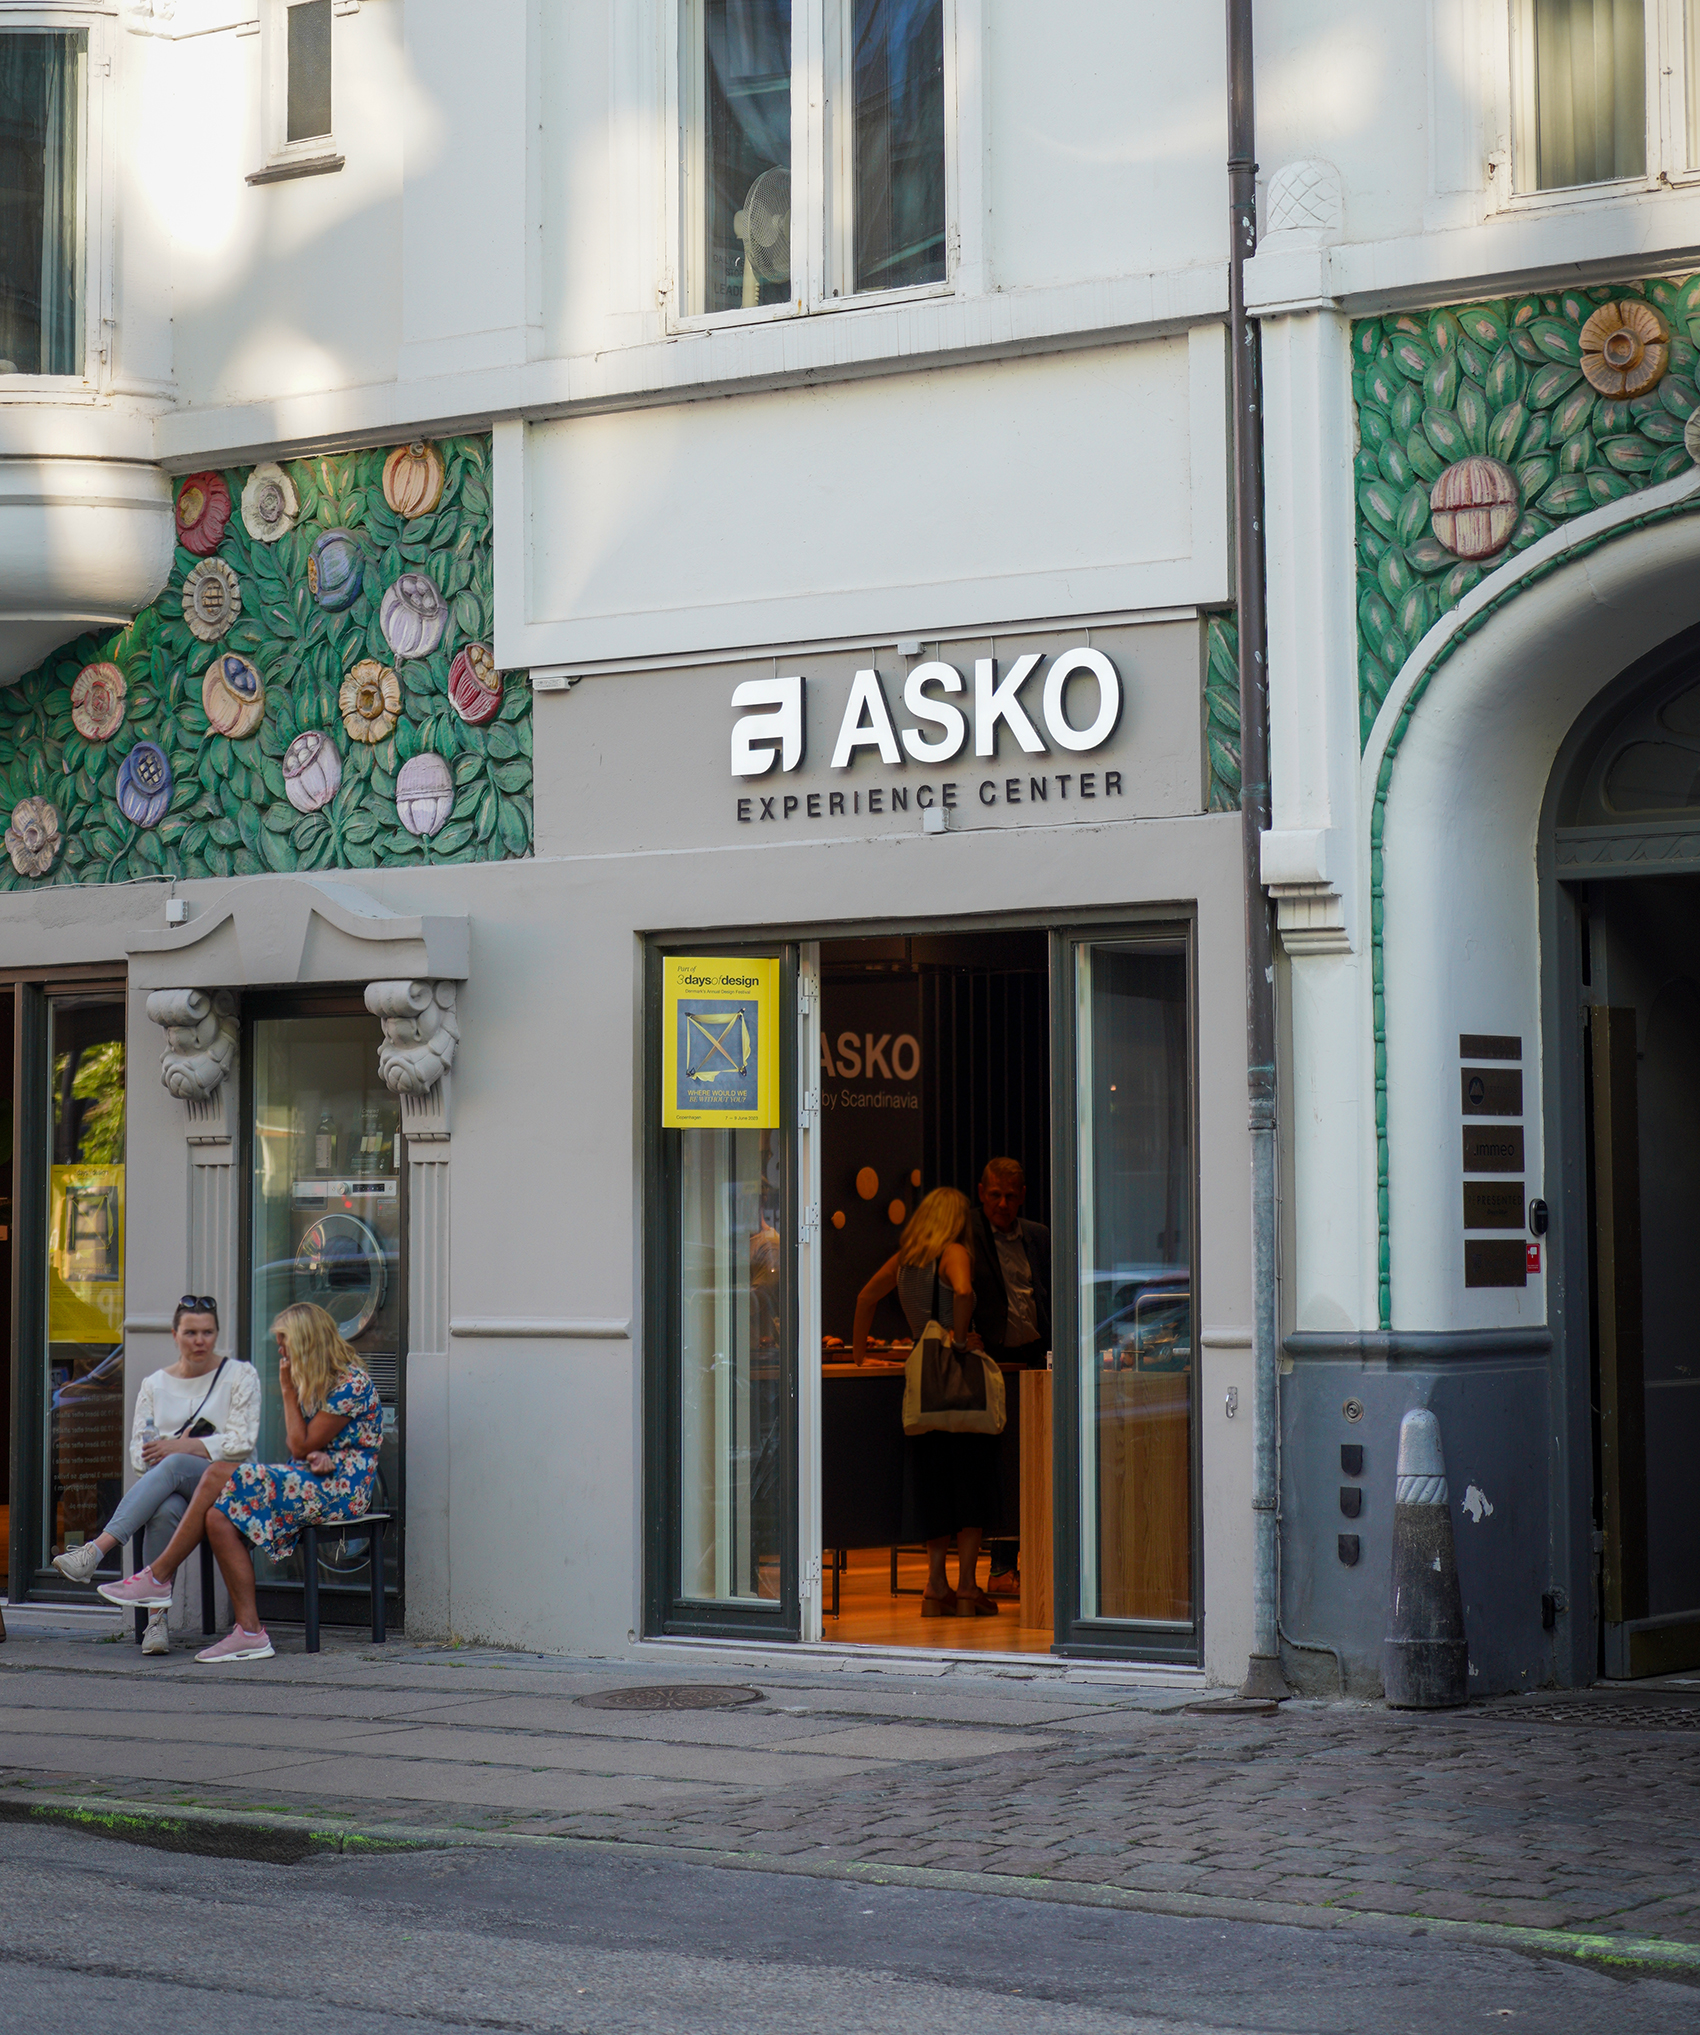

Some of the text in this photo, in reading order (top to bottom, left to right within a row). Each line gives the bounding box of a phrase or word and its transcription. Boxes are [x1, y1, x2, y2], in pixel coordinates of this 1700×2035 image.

[830, 647, 1124, 769] ASKO
[736, 770, 1122, 823] EXPERIENCE CENTER
[690, 965, 697, 974] of
[687, 1089, 747, 1097] WHERE WOULD WE
[821, 1089, 918, 1111] by Scandinavia
